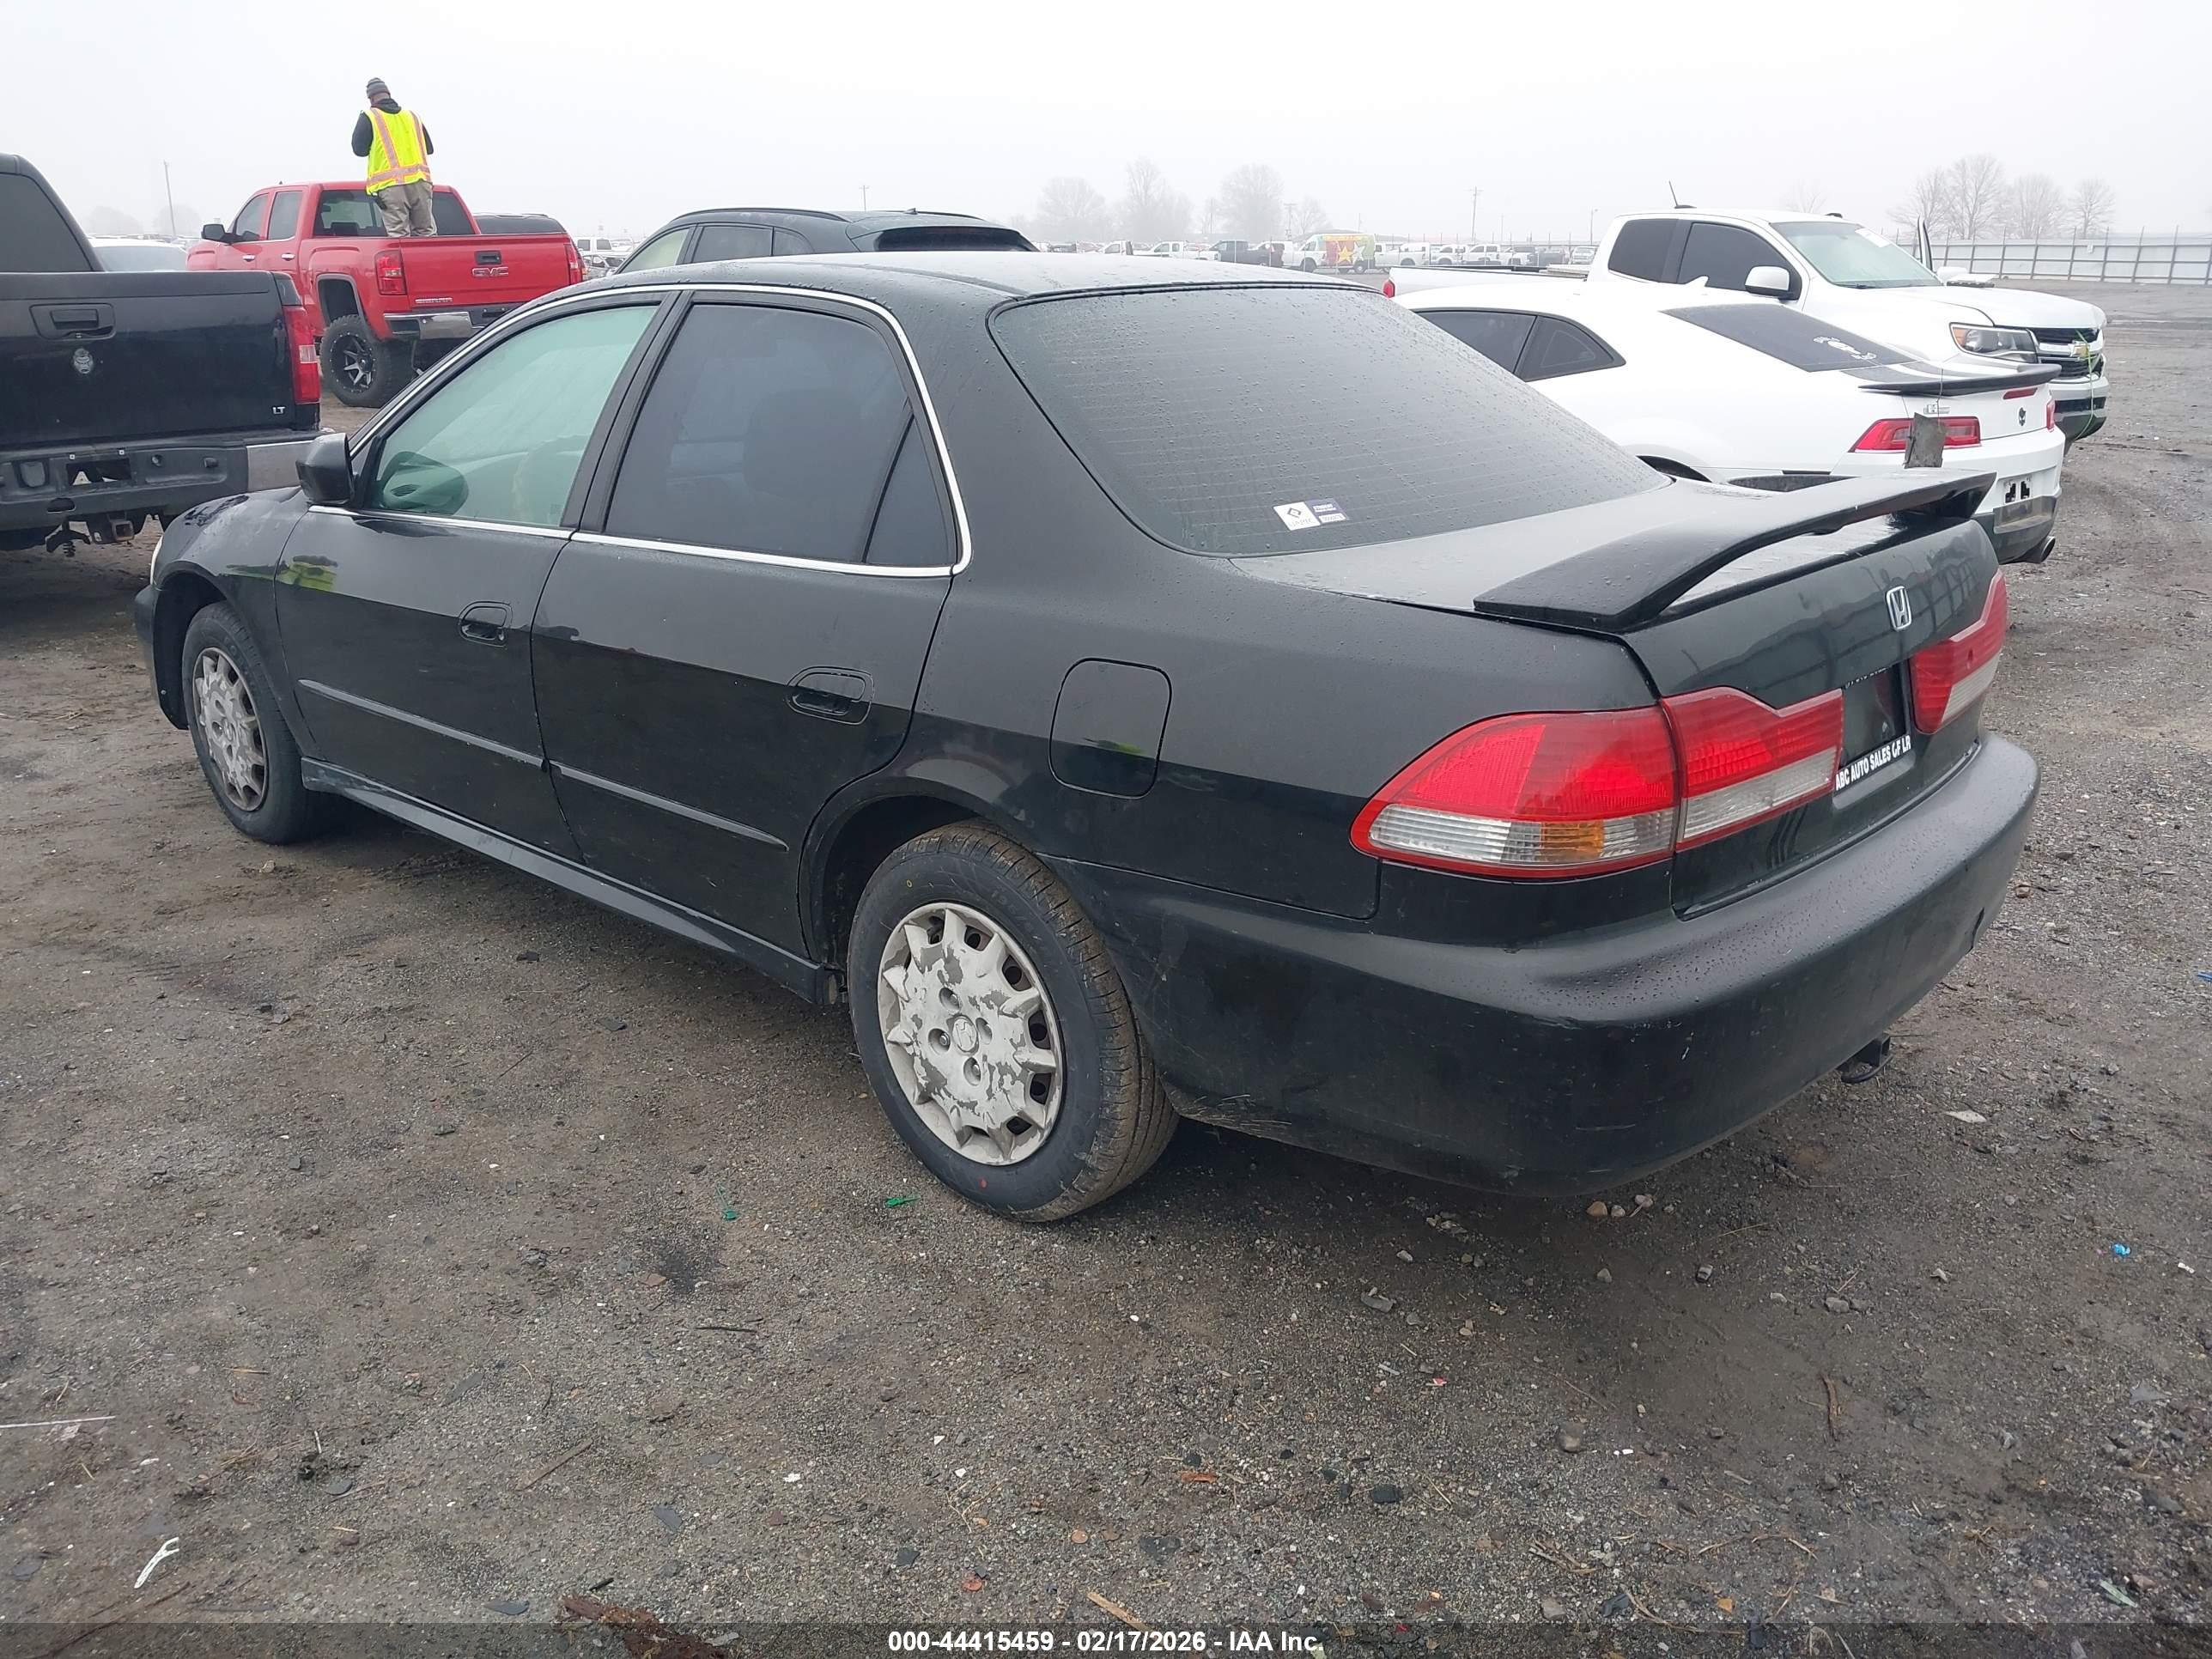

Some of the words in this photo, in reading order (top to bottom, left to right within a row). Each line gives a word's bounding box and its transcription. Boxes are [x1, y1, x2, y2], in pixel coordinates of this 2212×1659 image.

[471, 266, 509, 276] GMC
[272, 406, 286, 415] LT
[1835, 769, 1850, 791] ABC
[1850, 757, 1869, 782] AUTO
[1869, 745, 1892, 771] SALES
[1902, 735, 1911, 753] LR
